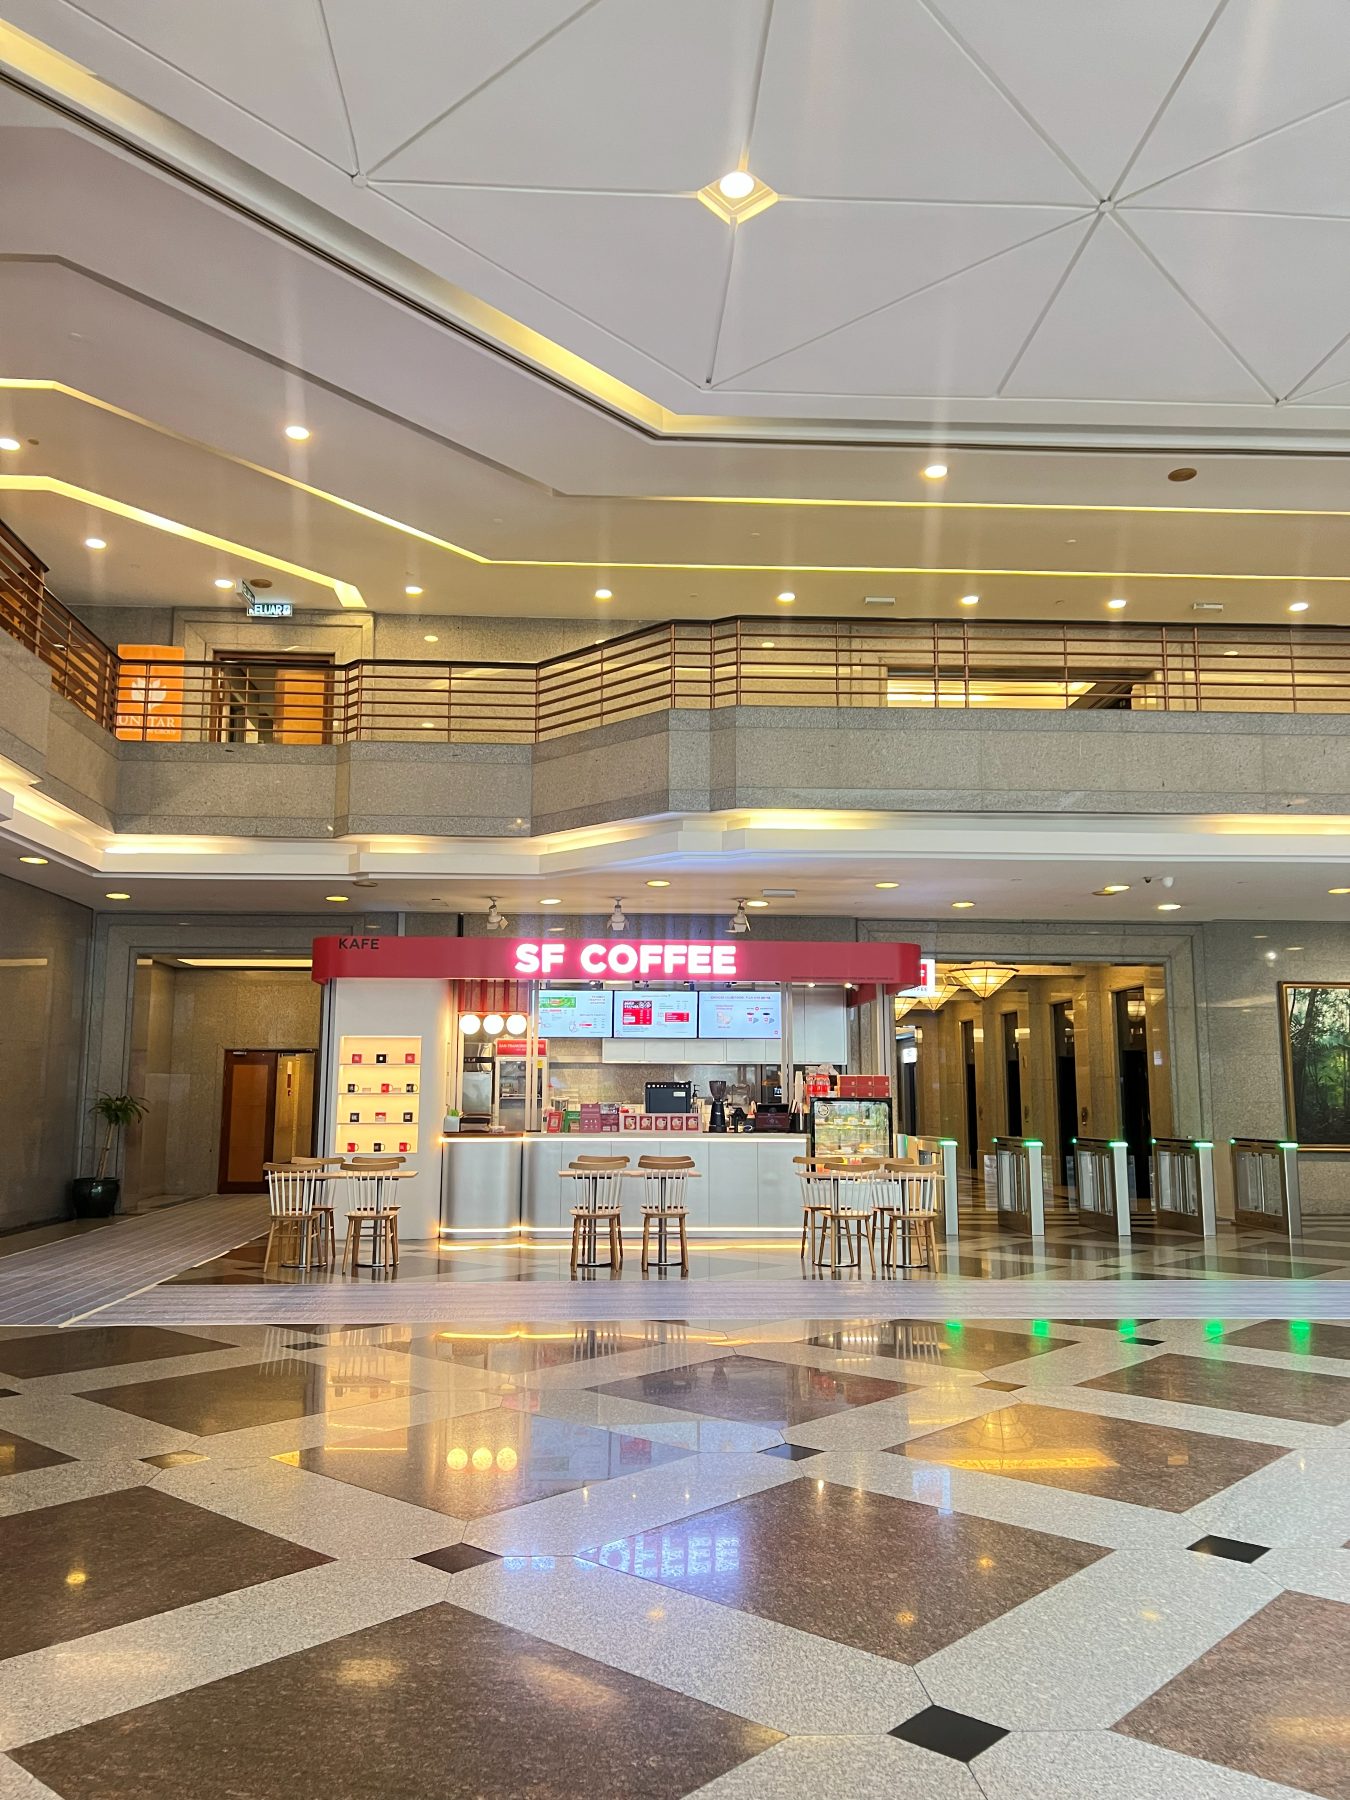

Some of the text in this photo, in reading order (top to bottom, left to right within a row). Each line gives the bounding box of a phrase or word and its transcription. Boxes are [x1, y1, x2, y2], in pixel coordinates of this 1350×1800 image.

[118, 716, 175, 728] UNTAR
[338, 938, 380, 950] KAFE
[514, 943, 737, 974] SF COFFEE
